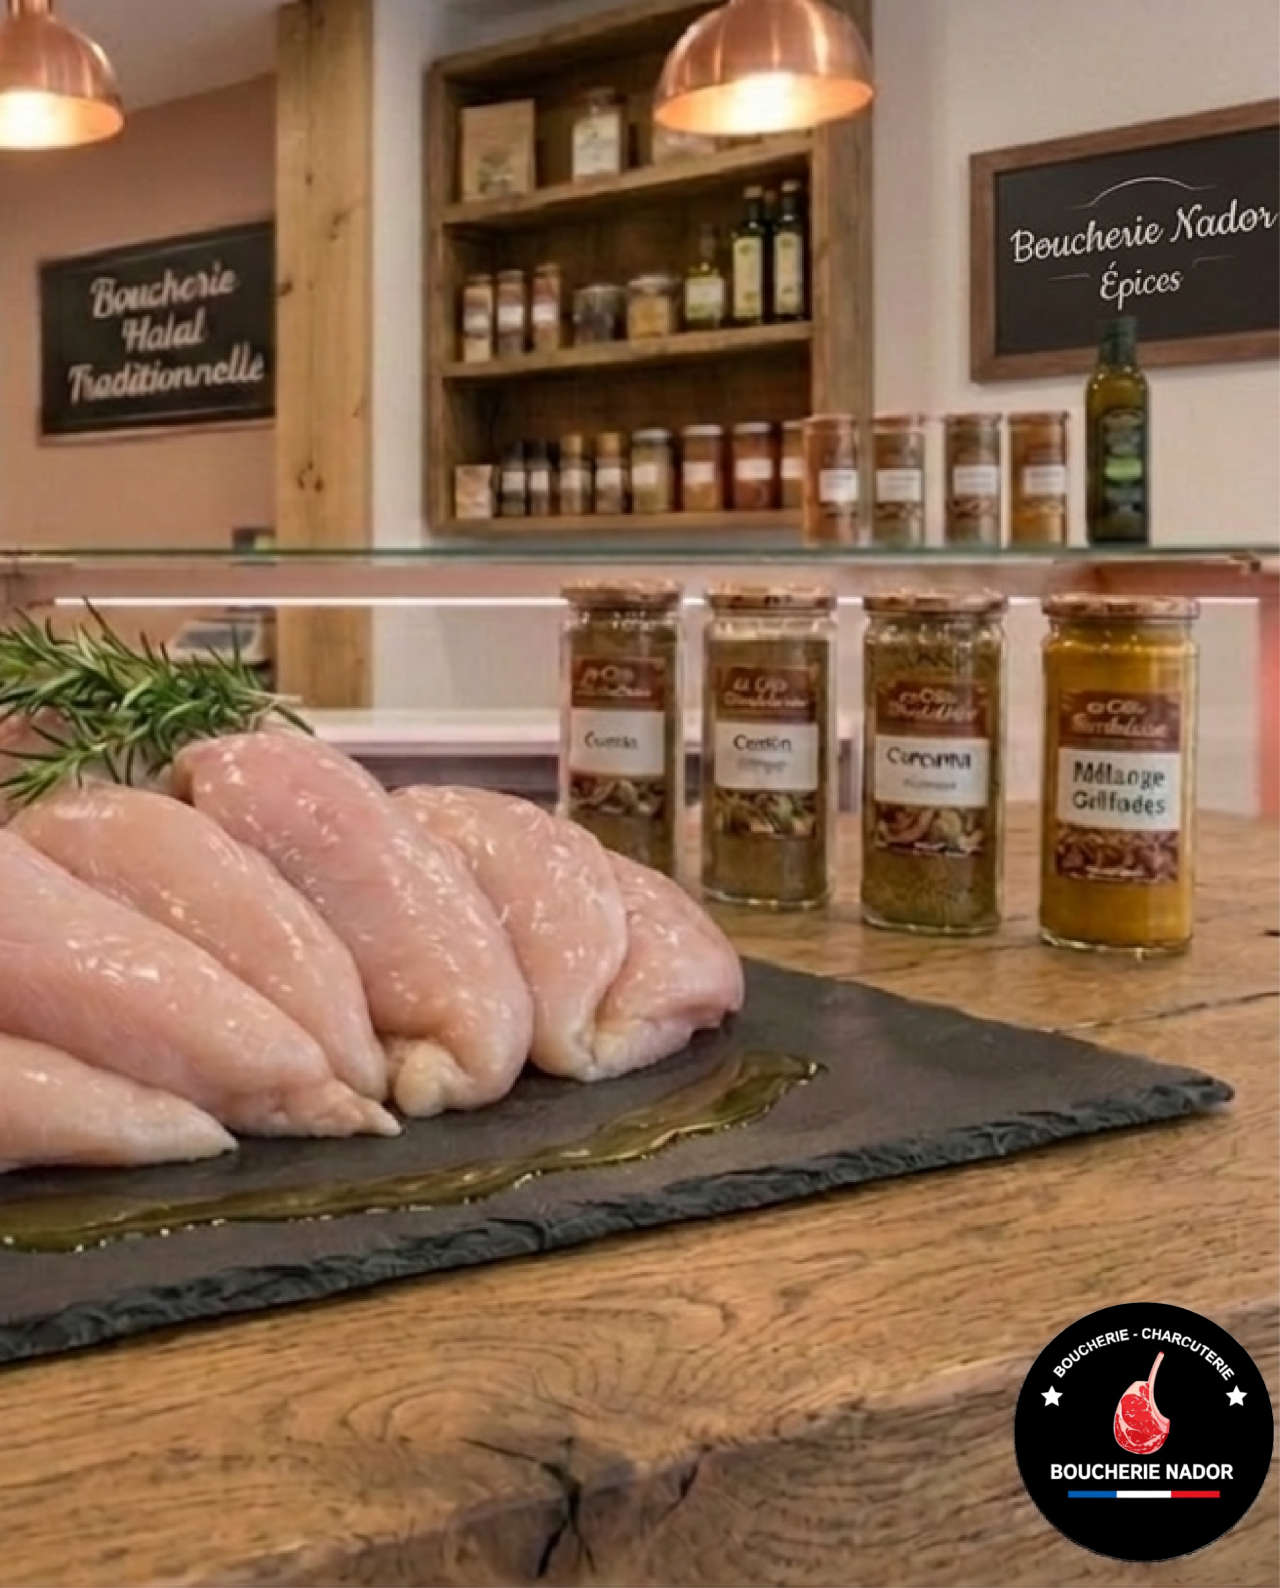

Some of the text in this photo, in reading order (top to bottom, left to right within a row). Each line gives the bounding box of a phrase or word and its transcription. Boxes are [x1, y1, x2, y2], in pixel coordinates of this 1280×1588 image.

[1010, 198, 1279, 263] Boucherie Nador
[89, 259, 239, 319] Boucherie
[1099, 261, 1184, 311] Épices
[122, 306, 208, 353] Halal
[68, 340, 266, 405] Traditionnelle
